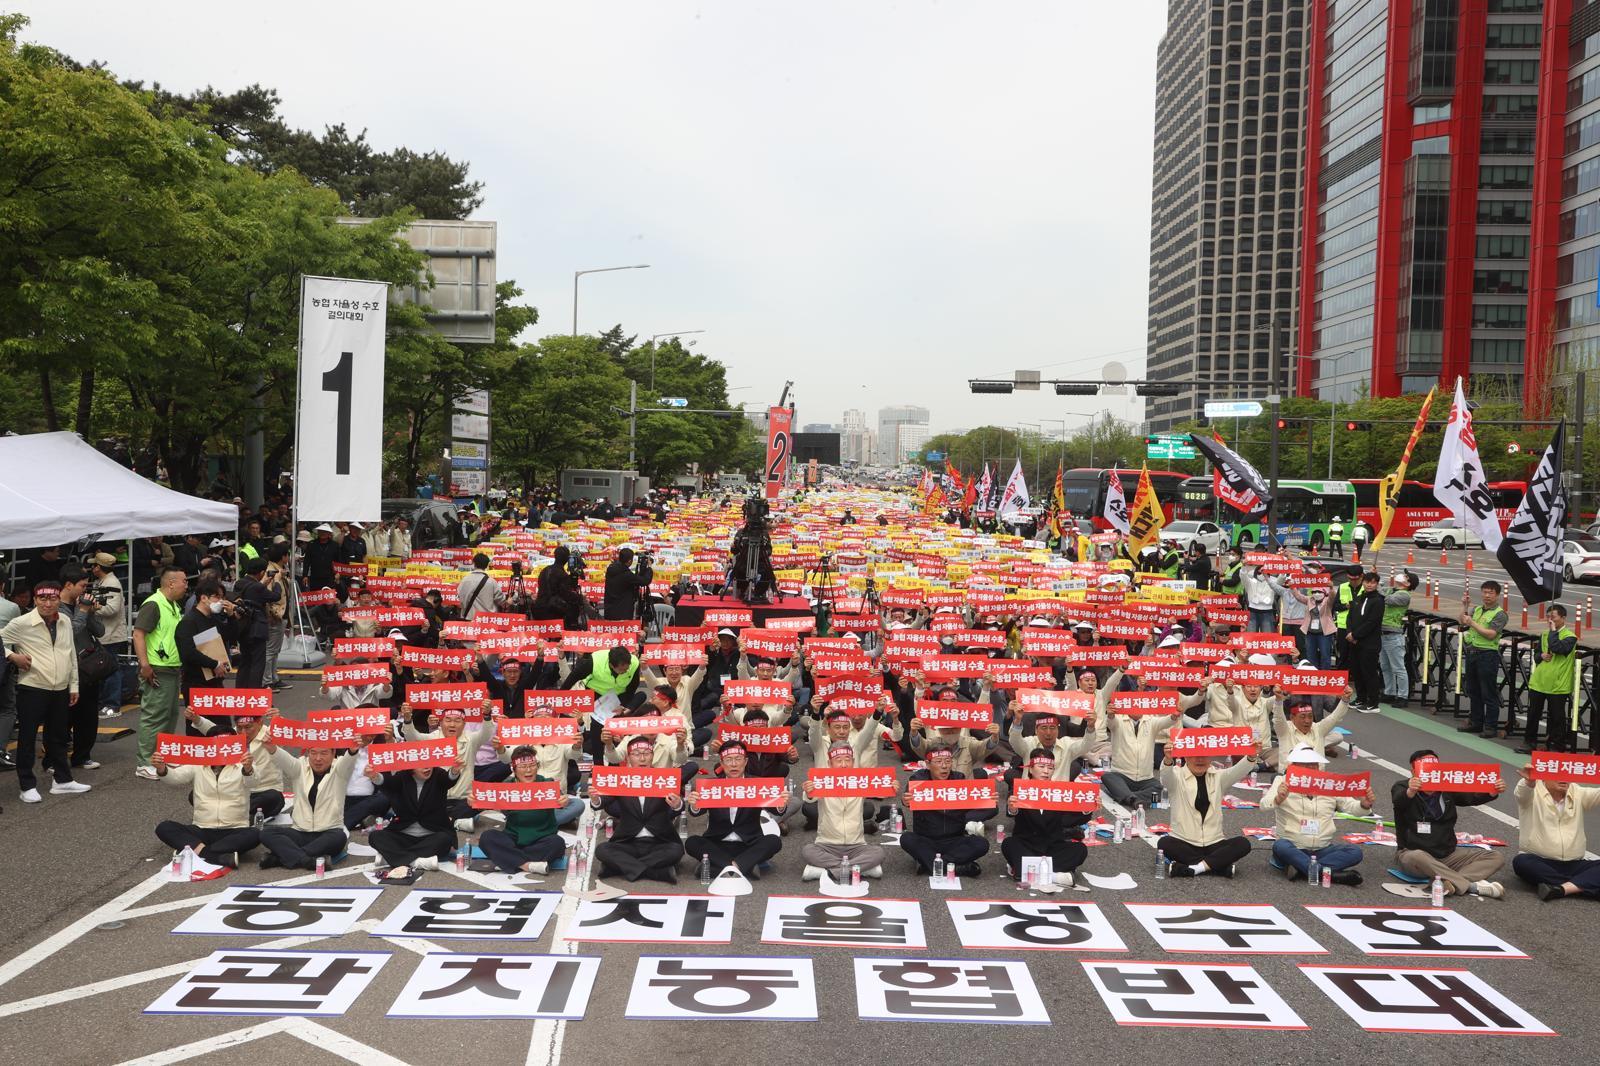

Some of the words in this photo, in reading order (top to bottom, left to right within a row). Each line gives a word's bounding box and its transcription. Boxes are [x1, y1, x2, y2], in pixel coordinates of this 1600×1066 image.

[312, 298, 330, 308] 농협
[333, 298, 360, 310] 자율성
[362, 301, 380, 311] 수호
[328, 310, 364, 322] 결의대회
[322, 352, 353, 475] 1
[768, 431, 787, 482] 2
[1099, 624, 1112, 632] 농협
[1114, 626, 1134, 634] 자율성
[1135, 627, 1150, 637] 수호
[337, 643, 351, 652] 농협
[353, 642, 376, 652] 자율성
[377, 642, 393, 652] 수호
[564, 636, 578, 646] 농협
[580, 637, 603, 647] 자율성
[604, 639, 619, 647] 수호
[1245, 640, 1258, 648] 농협
[646, 649, 660, 658] 농협
[662, 649, 684, 659] 자율성
[686, 649, 703, 659] 수호
[1071, 651, 1086, 660] 농협
[1088, 651, 1109, 660] 자율성
[1111, 650, 1128, 659] 수호
[1182, 646, 1195, 656] 농협
[1196, 648, 1216, 656] 자율성
[1217, 649, 1233, 658] 수호
[816, 660, 831, 669] 농협
[832, 661, 854, 670] 자율성
[856, 661, 870, 670] 수호
[922, 660, 939, 670] 농협
[941, 660, 966, 670] 자율성
[968, 661, 984, 670] 수호
[326, 671, 342, 680] 농협
[344, 668, 368, 679] 자율성
[370, 667, 387, 677] 수호
[995, 670, 1010, 682] 농협
[1012, 672, 1035, 682] 자율성
[1037, 672, 1052, 682] 수호
[1144, 671, 1160, 680] 농협
[1161, 672, 1184, 680] 자율성
[1186, 672, 1203, 682] 수호
[1211, 670, 1226, 679] 농협
[1232, 670, 1248, 680] 농협
[1250, 670, 1273, 680] 자율성
[1282, 674, 1299, 684] 농협
[1301, 675, 1326, 685] 자율성
[1328, 676, 1344, 686] 수호
[727, 686, 743, 696] 농협
[745, 686, 770, 696] 자율성
[772, 687, 788, 697] 수호
[817, 683, 834, 696] 농협
[836, 681, 861, 691] 자율성
[864, 683, 883, 695] 수호
[193, 695, 212, 706] 농협
[215, 695, 244, 707] 자율성
[247, 696, 268, 707] 수호
[409, 690, 428, 702] 농협
[431, 690, 460, 701] 자율성
[463, 689, 485, 701] 수호
[527, 696, 544, 706] 농협
[546, 696, 571, 706] 자율성
[574, 696, 591, 706] 수호
[1021, 694, 1040, 704] 농협
[1041, 695, 1069, 710] 자율성
[1071, 699, 1090, 709] 수호
[1114, 698, 1130, 708] 농협
[1133, 697, 1157, 708] 자율성
[1160, 697, 1175, 707] 수호
[919, 706, 938, 718] 농협
[940, 708, 968, 720] 자율성
[970, 710, 988, 721] 수호
[362, 716, 388, 728] 수호
[608, 719, 628, 729] 농협
[630, 718, 658, 728] 자율성
[660, 717, 678, 727] 수호
[272, 724, 292, 738] 농협
[295, 728, 328, 740] 자율성
[331, 727, 355, 740] 수호
[501, 725, 520, 737] 농협
[522, 725, 551, 736] 자율성
[554, 724, 573, 736] 수호
[721, 730, 739, 741] 농협
[741, 733, 770, 745] 자율성
[772, 733, 789, 745] 수호
[1173, 734, 1194, 748] 농협
[1197, 734, 1227, 747] 자율성
[1230, 733, 1252, 746] 수호
[158, 741, 180, 755] 농협
[183, 744, 216, 757] 자율성
[219, 742, 242, 756] 수호
[372, 751, 393, 764] 농협
[396, 747, 429, 761] 자율성
[432, 745, 454, 758] 수호
[1535, 759, 1559, 773] 농협
[1561, 760, 1597, 776] 자율성
[596, 774, 617, 787] 농협
[620, 774, 652, 788] 자율성
[655, 776, 676, 788] 수호
[812, 776, 833, 788] 농협
[836, 776, 868, 788] 자율성
[871, 775, 894, 788] 수호
[1287, 773, 1311, 787] 농협
[1312, 778, 1345, 790] 자율성
[1347, 779, 1366, 790] 수호
[1418, 769, 1440, 783] 농협
[1442, 770, 1474, 783] 자율성
[1476, 772, 1499, 784] 수호
[475, 789, 496, 801] 농협
[499, 789, 531, 801] 자율성
[534, 788, 556, 800] 수호
[700, 786, 721, 799] 농협
[724, 785, 755, 798] 자율성
[758, 786, 781, 798] 수호
[912, 788, 933, 801] 농협
[936, 787, 967, 800] 자율성
[970, 787, 991, 799] 수호
[1017, 786, 1038, 800] 농협
[1040, 788, 1072, 802] 자율성
[1074, 790, 1096, 802] 수호
